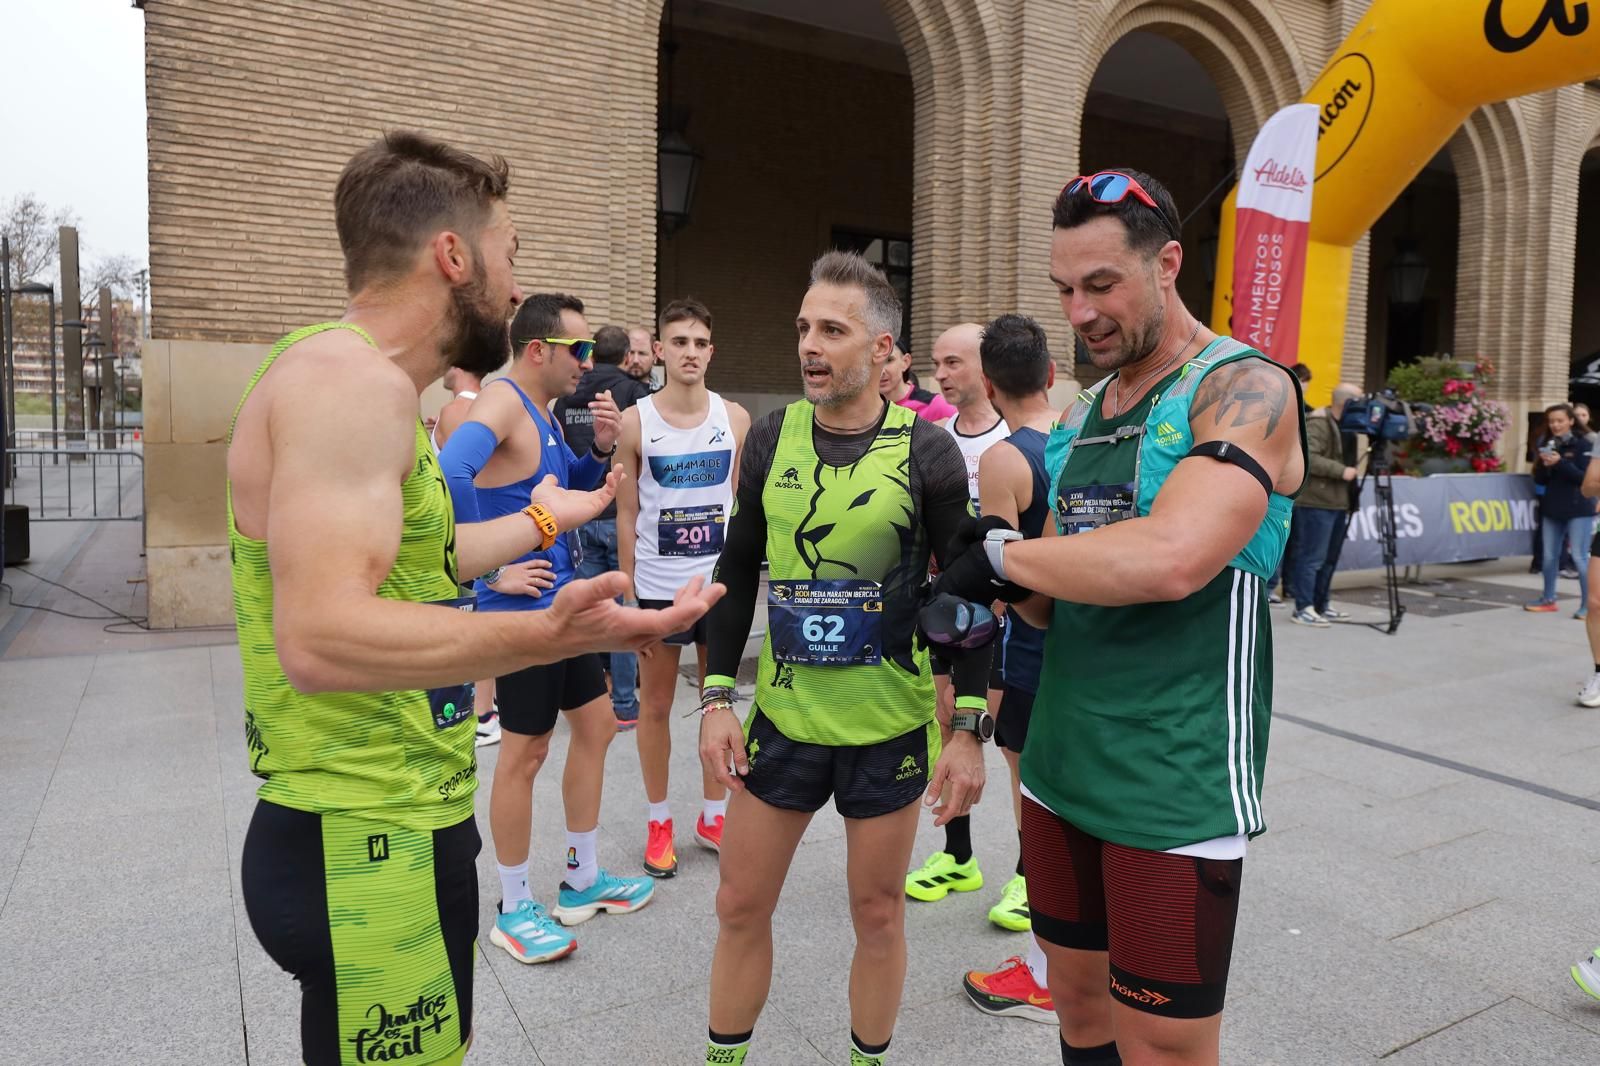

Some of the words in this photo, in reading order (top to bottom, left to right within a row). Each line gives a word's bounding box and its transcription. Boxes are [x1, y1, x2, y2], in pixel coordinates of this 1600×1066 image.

[1249, 233, 1269, 344] ALIMENTOS
[663, 459, 706, 472] ALHAMA
[708, 458, 721, 468] DE
[670, 472, 715, 484] ARAGÓN
[675, 525, 711, 545] 201
[794, 590, 810, 598] RODI
[810, 590, 827, 598] MEDIA
[826, 590, 852, 598] MARATÓN
[852, 590, 880, 598] IBERCAJA
[820, 597, 849, 605] ZARAGOZA
[802, 614, 846, 642] 62
[808, 644, 839, 652] GUILLE
[366, 993, 448, 1038] Juntos
